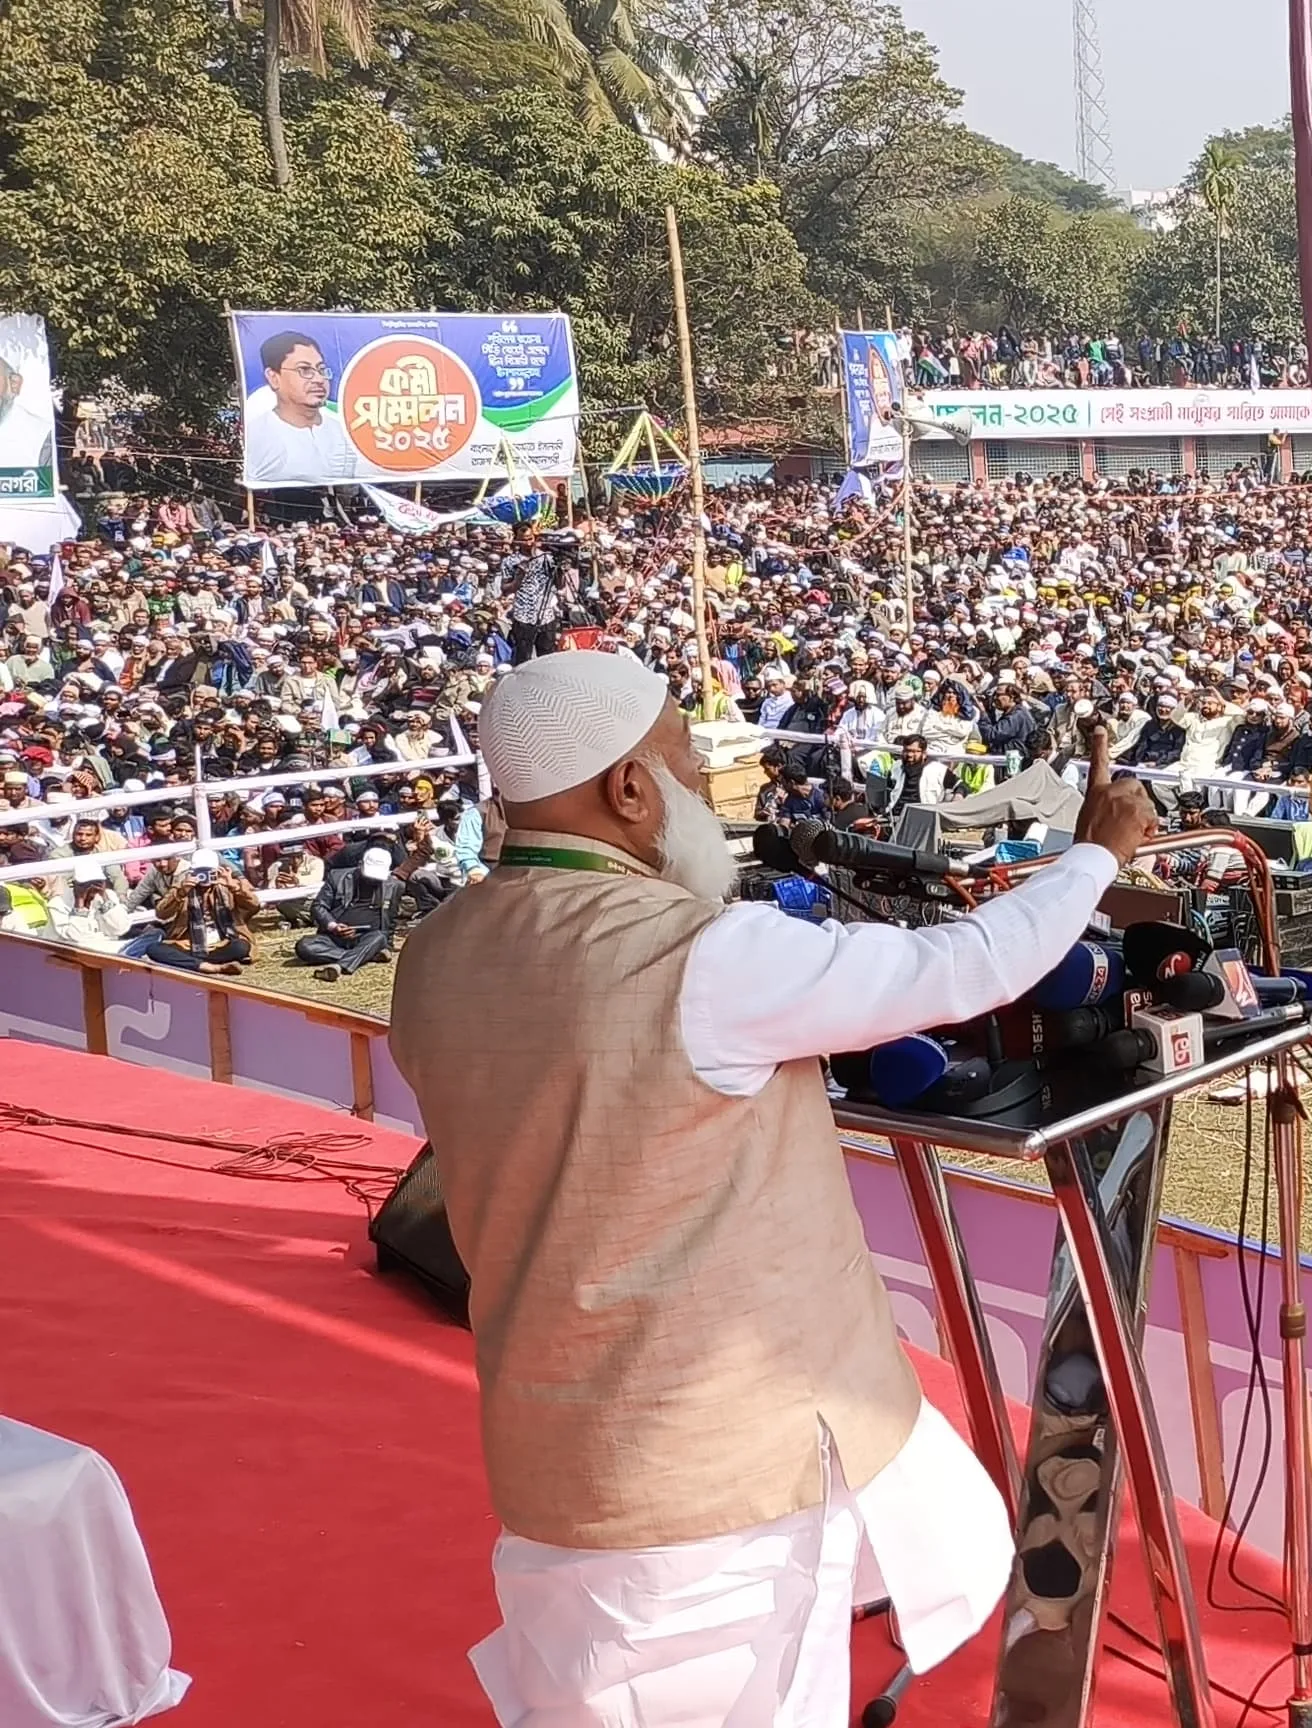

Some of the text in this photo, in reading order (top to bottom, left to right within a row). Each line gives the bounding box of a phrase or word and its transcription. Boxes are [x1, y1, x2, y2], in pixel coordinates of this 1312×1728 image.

[350, 394, 466, 433] সম্মেলন
[1100, 403, 1124, 424] সেই
[375, 426, 451, 452] ২০২৫
